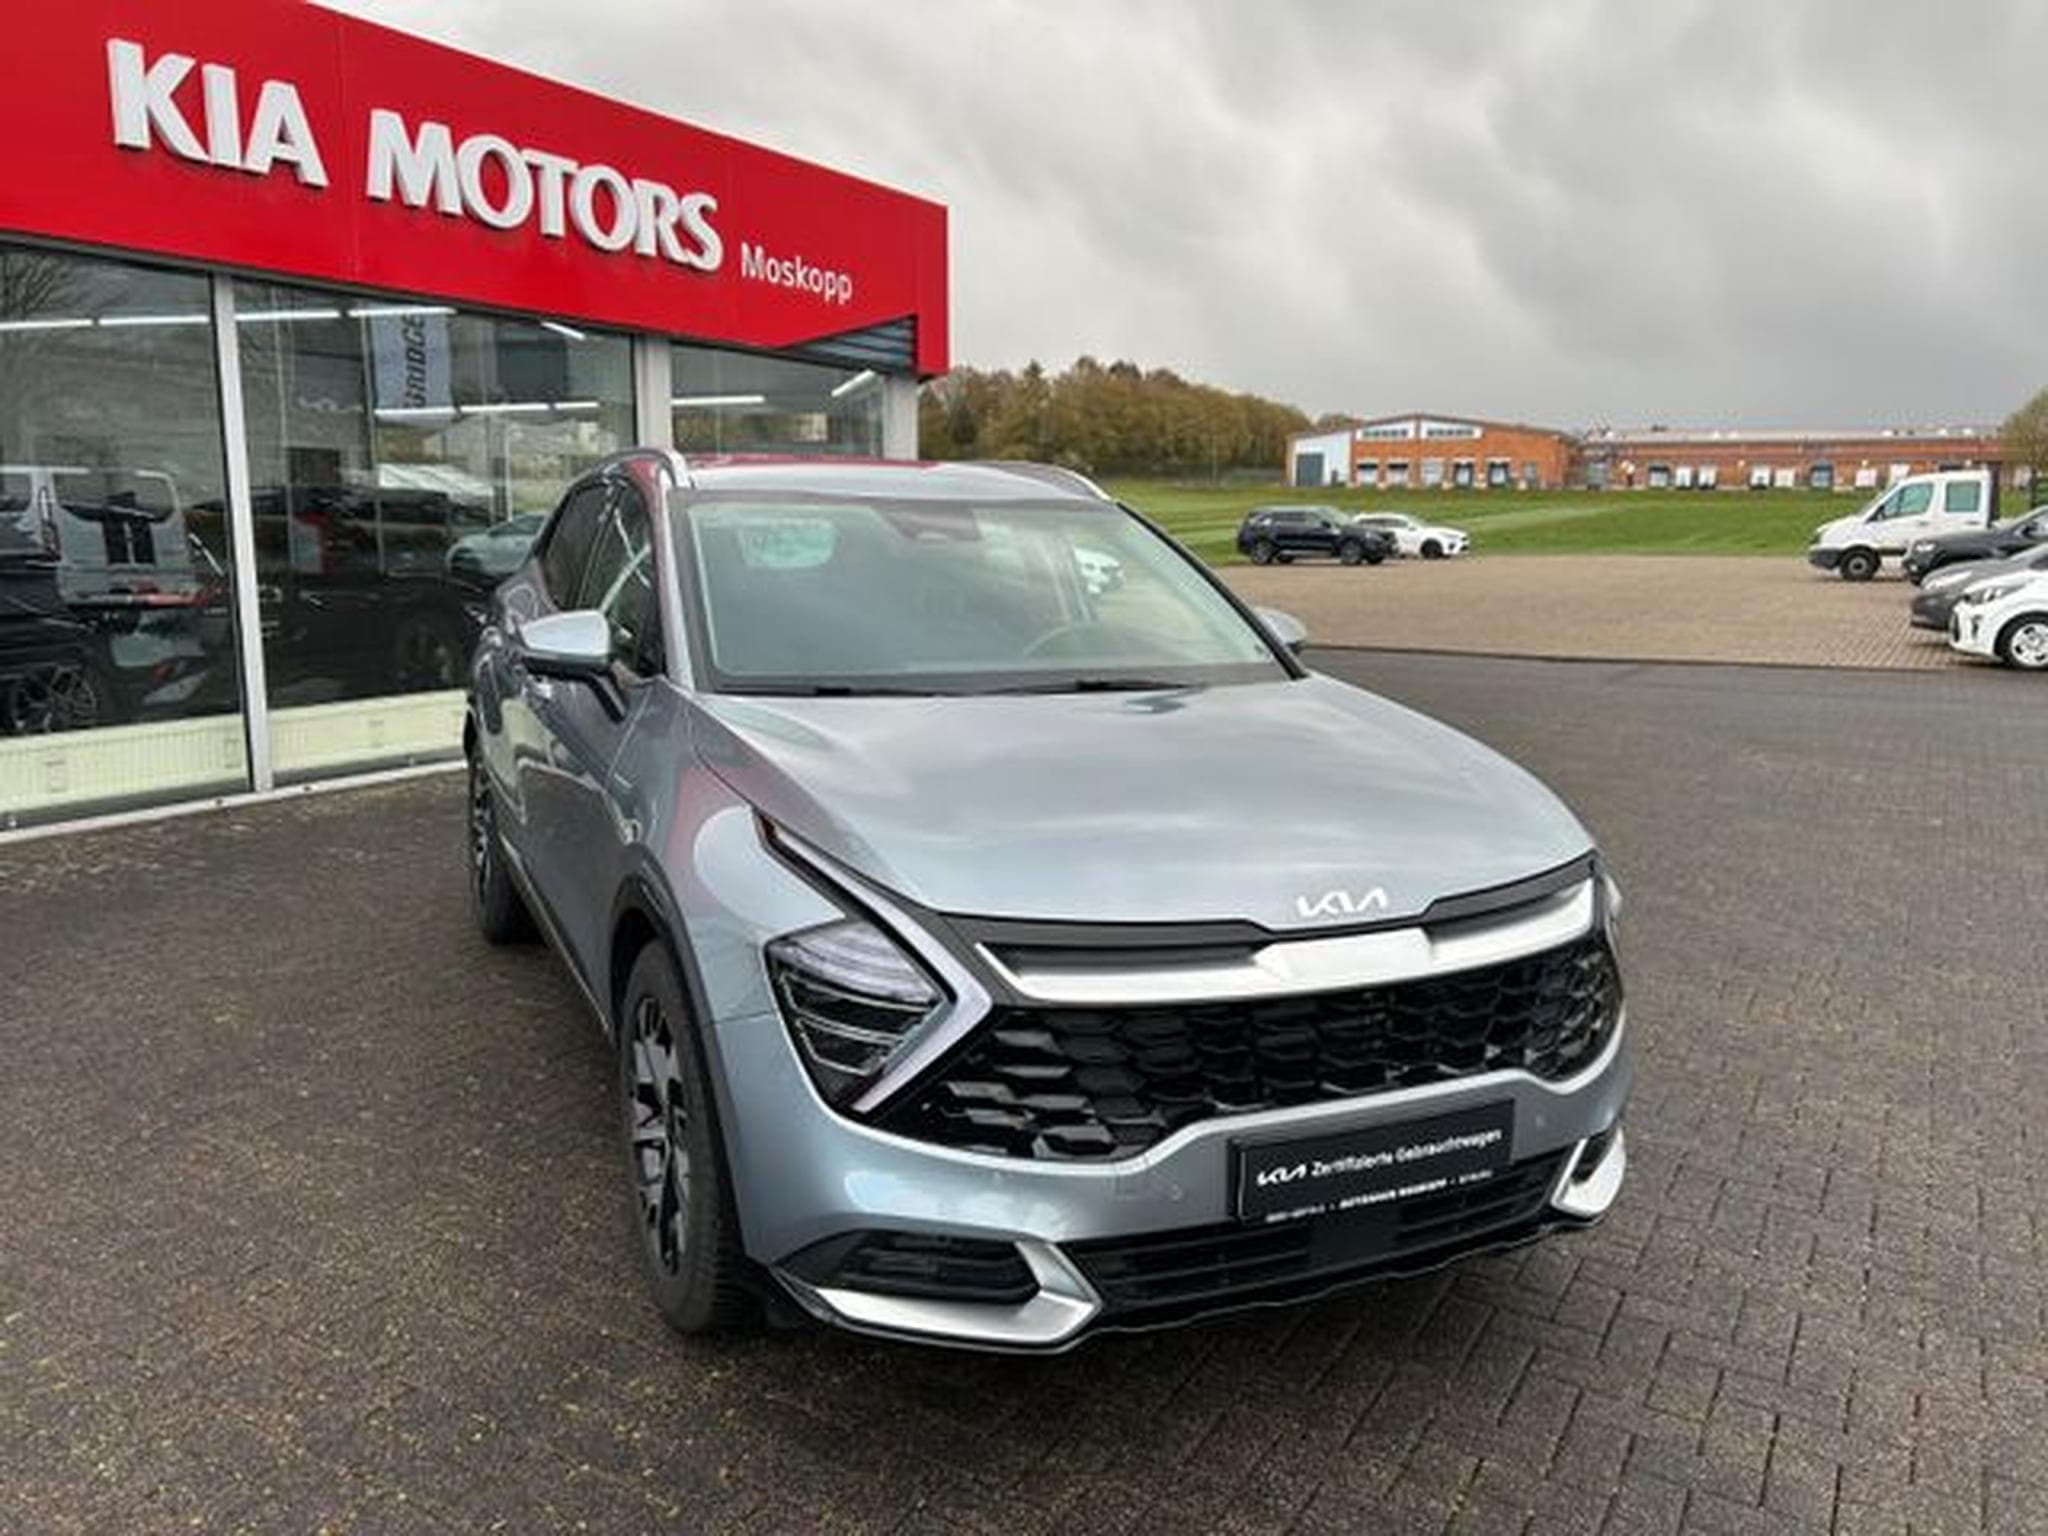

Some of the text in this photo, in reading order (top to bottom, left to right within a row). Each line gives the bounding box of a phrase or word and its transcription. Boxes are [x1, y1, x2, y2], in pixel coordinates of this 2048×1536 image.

[107, 38, 724, 272] KIA MOTORS
[741, 241, 853, 304] Moskopp
